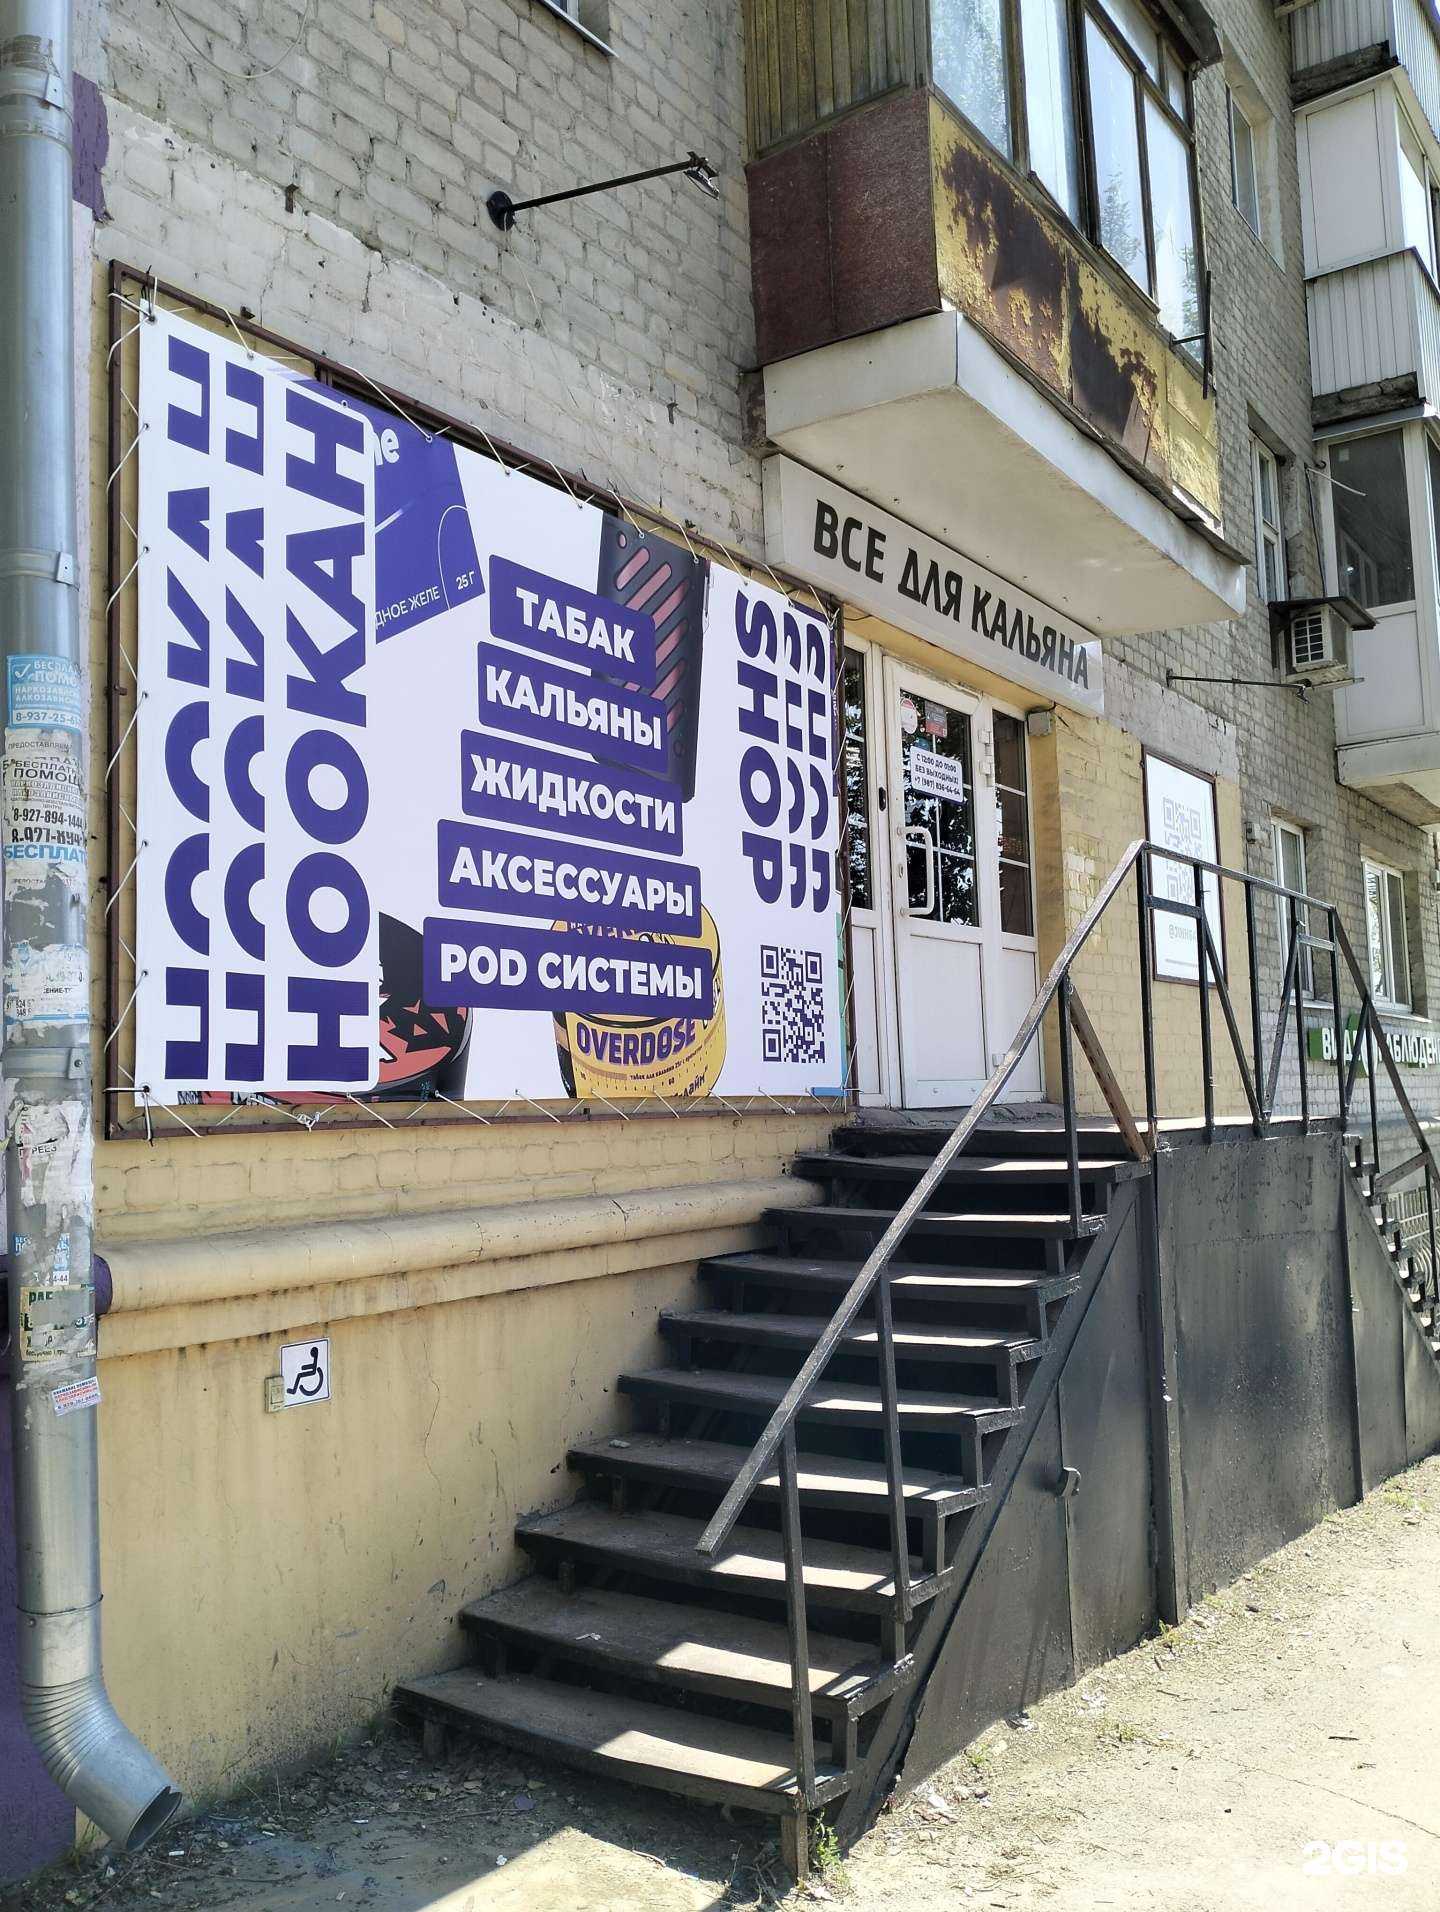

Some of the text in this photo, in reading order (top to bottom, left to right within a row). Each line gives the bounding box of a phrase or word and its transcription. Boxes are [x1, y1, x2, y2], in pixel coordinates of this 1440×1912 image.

[410, 585, 441, 611] ЖЕЛЕ
[455, 575, 470, 591] 25
[813, 498, 1089, 690] ВСЕ ДЛЯ КАЛЬЯНА
[515, 588, 636, 664] ТАБАК
[285, 387, 371, 1082] HOOKAH
[486, 664, 664, 751] КАЛЬЯНЫ
[735, 589, 783, 905] SHOP
[470, 753, 677, 835] ЖИДКОСТИ
[449, 846, 694, 918] АКСЕССУАРЫ
[440, 943, 529, 987] POD
[538, 951, 703, 1000] СИСТЕМЫ
[576, 1017, 696, 1067] OVERDOSE
